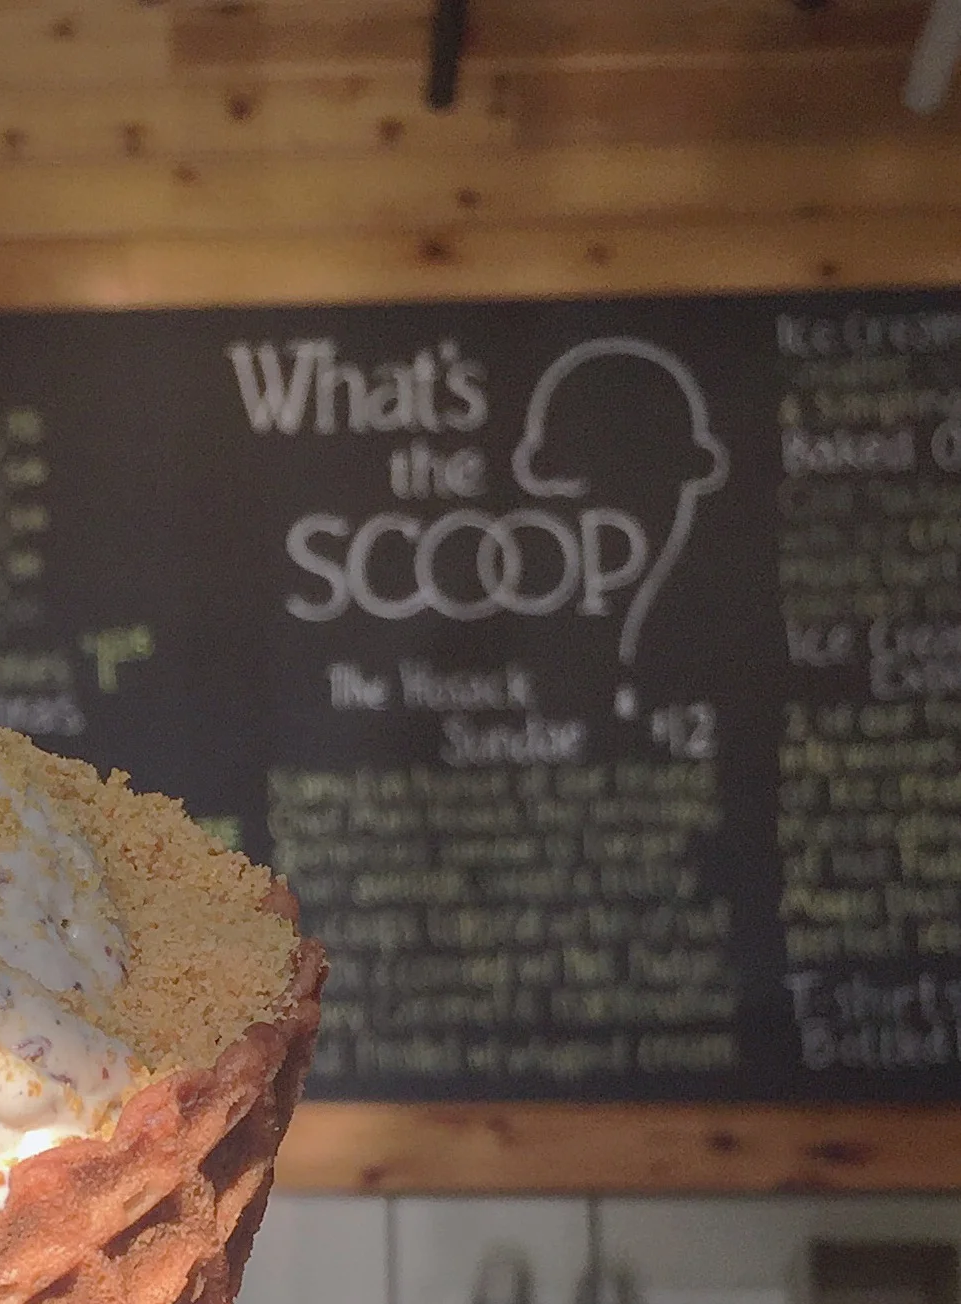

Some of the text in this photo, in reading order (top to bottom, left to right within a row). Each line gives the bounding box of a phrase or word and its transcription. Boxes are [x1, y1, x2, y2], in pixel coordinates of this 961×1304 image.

[226, 339, 490, 436] What's
[388, 440, 488, 499] the
[285, 508, 650, 622] SCOOP
